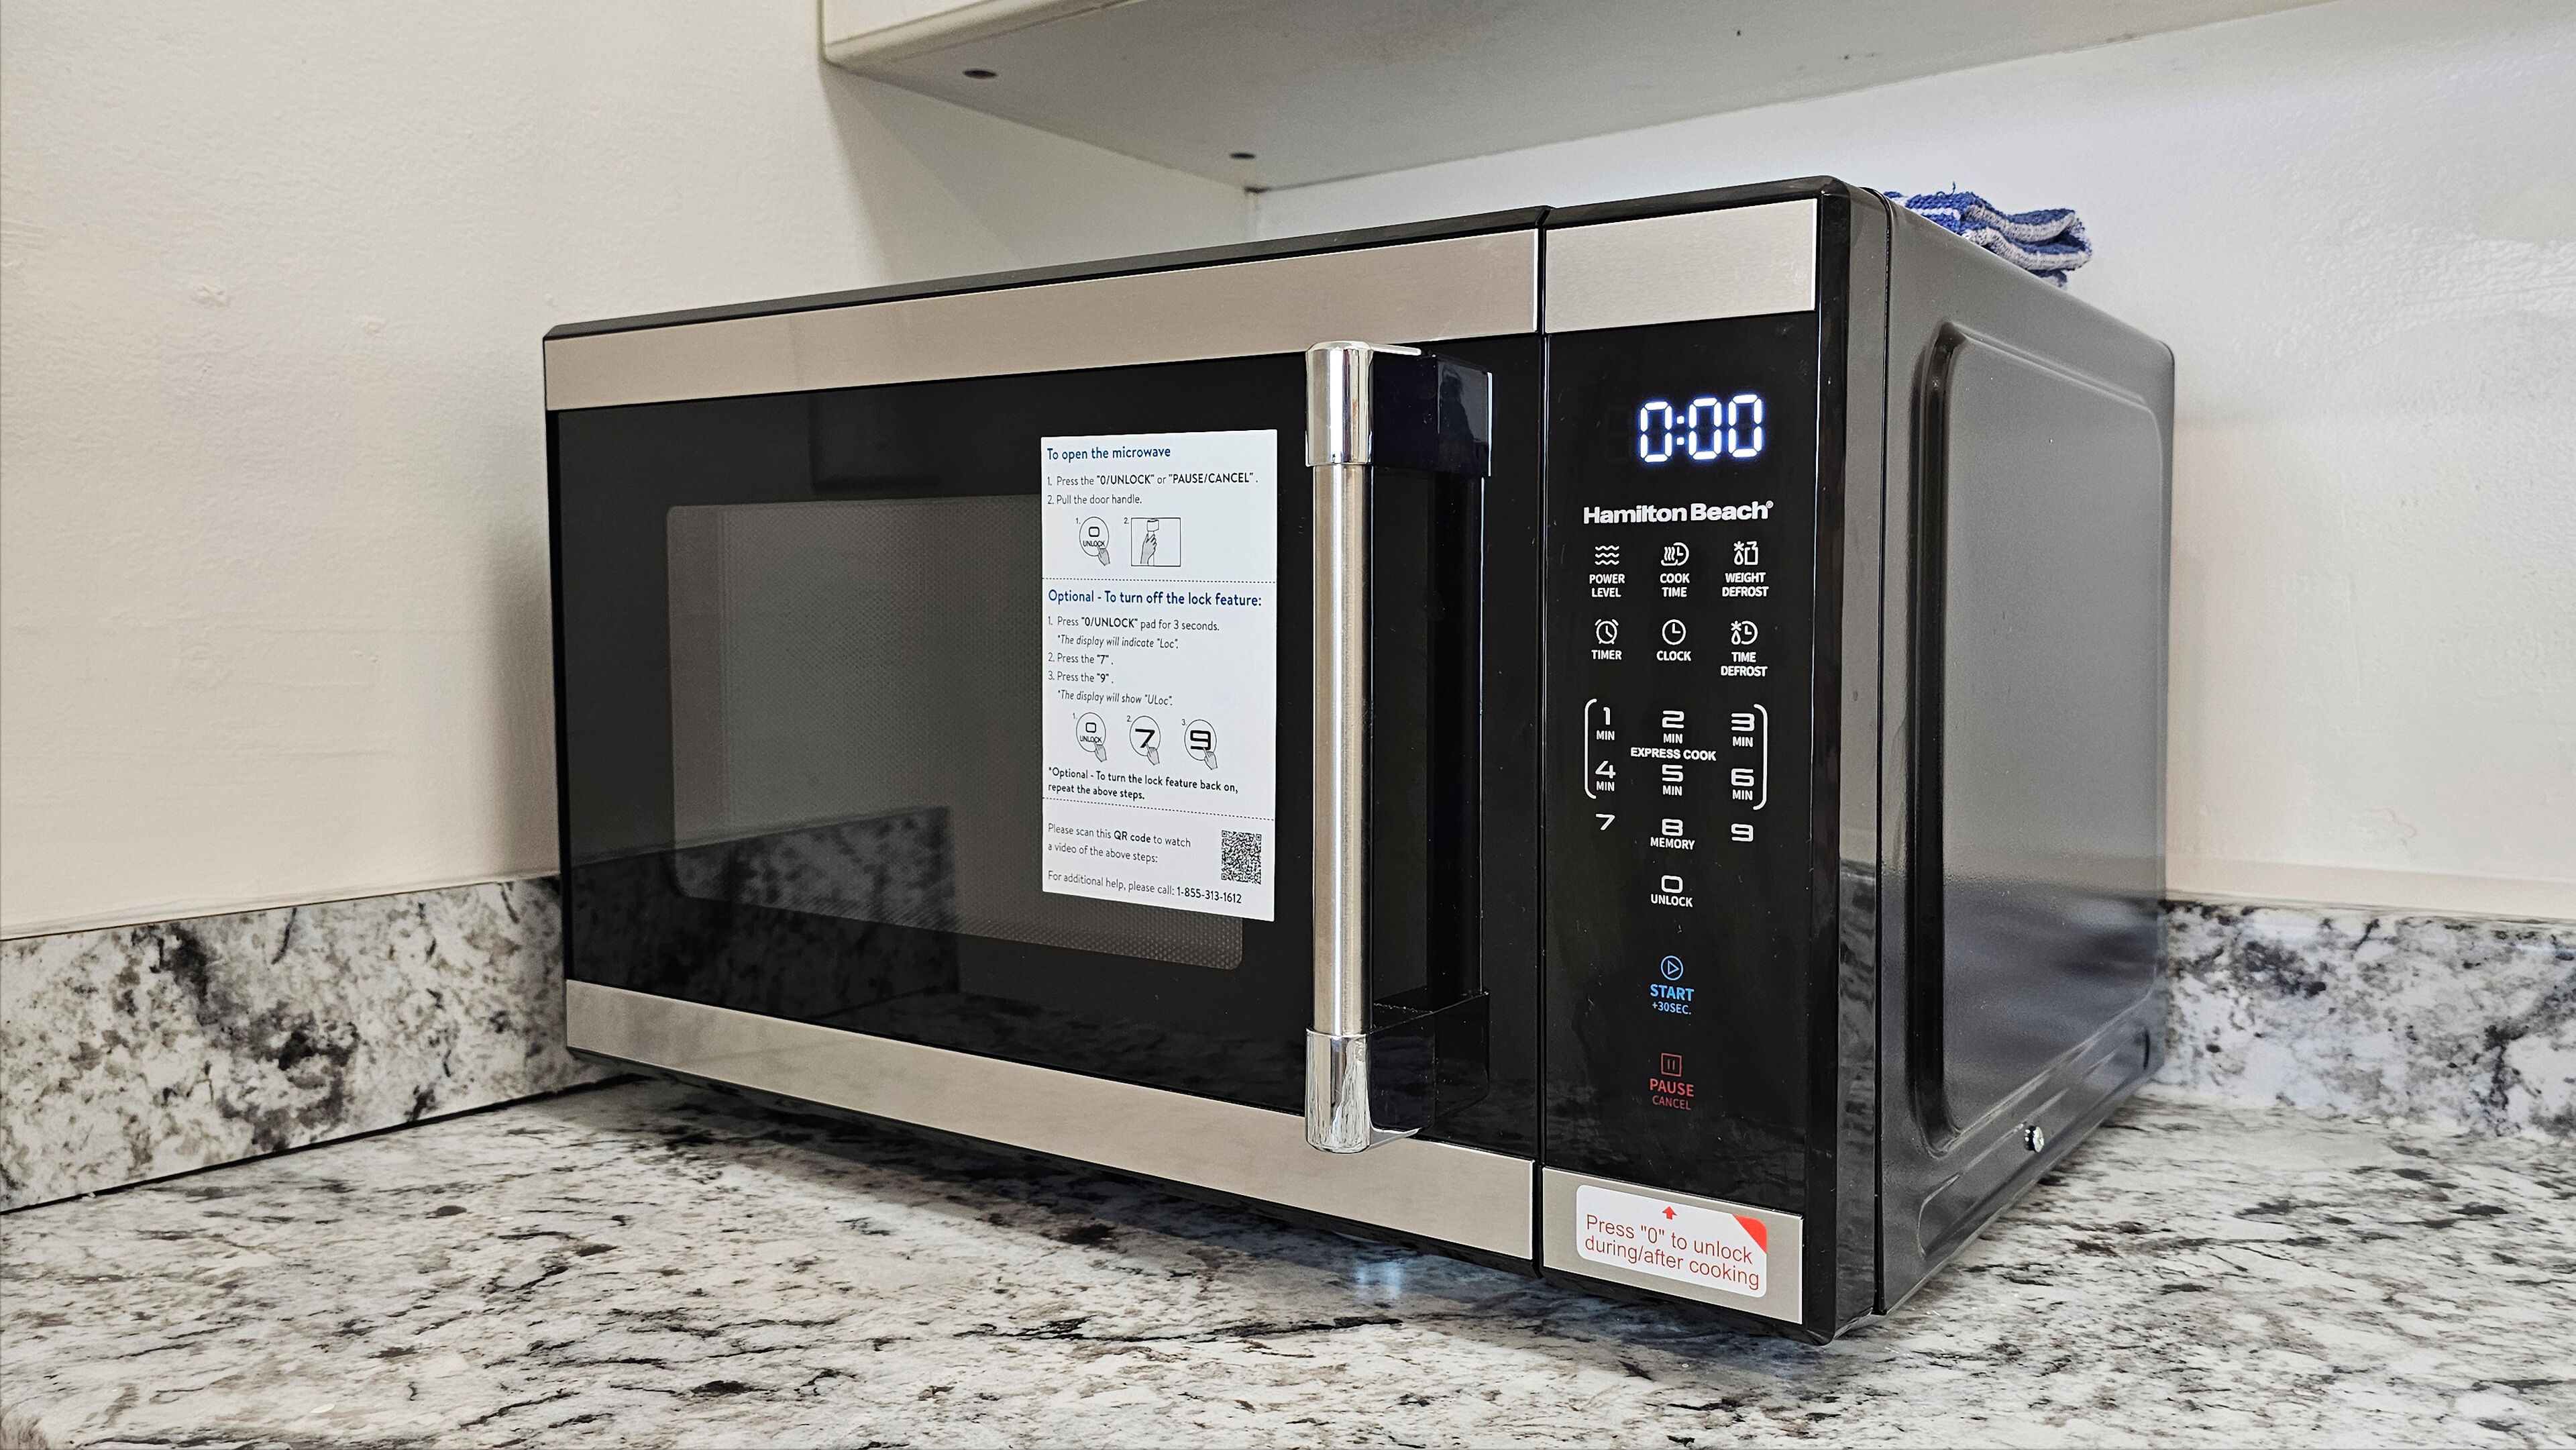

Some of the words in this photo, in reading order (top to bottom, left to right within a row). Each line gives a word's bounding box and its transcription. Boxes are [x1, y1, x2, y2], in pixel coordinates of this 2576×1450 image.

[1640, 394, 1763, 463] 0:00
[1047, 448, 1059, 460] To
[1062, 448, 1087, 462] open
[1091, 447, 1109, 460] the
[1112, 447, 1171, 458] microwave
[1047, 476, 1052, 486] 1.
[1057, 476, 1078, 486] Press
[1081, 475, 1094, 485] the
[1157, 476, 1166, 484] or
[1047, 496, 1054, 505] 2.
[1057, 495, 1071, 505] Pull
[1074, 495, 1087, 504] the
[1089, 495, 1110, 504] door
[1112, 495, 1142, 504] handle.
[1583, 505, 1687, 524] Hamilton
[1589, 574, 1625, 584] POWER
[1660, 573, 1690, 583] COOK
[1725, 572, 1766, 582] WEIGHT
[1049, 589, 1094, 605] Optional
[1104, 590, 1116, 603] To
[1120, 592, 1143, 603] turn
[1146, 591, 1163, 604] off
[1166, 592, 1185, 604] the
[1188, 592, 1212, 605] lock
[1215, 593, 1262, 606] feature:
[1591, 588, 1621, 598] LEVEL
[1662, 587, 1686, 597] TIME
[1722, 586, 1769, 597] DEFROST
[1048, 617, 1053, 625] 1.
[1057, 617, 1079, 626] Press
[1140, 619, 1156, 631] pad
[1159, 619, 1171, 629] for
[1174, 620, 1179, 629] 3
[1181, 621, 1220, 631] seconds.
[1076, 636, 1104, 648] display
[1107, 637, 1120, 646] will
[1122, 637, 1154, 648] indicate
[1049, 654, 1055, 662] 2.
[1057, 653, 1079, 664] Press
[1081, 654, 1094, 664] the
[1591, 650, 1622, 660] TIMER
[1656, 651, 1691, 662] CLOCK
[1731, 652, 1756, 662] TIME
[1049, 671, 1055, 680] 3.
[1057, 672, 1079, 682] Press
[1081, 673, 1094, 682] the
[1721, 666, 1768, 677] DEFROST
[1076, 691, 1104, 703] display
[1107, 692, 1120, 703] will
[1122, 693, 1142, 704] show
[1603, 707, 1610, 725] 1
[1662, 710, 1684, 729] 2
[1731, 713, 1755, 731] 3
[1135, 728, 1155, 748] 7
[1190, 729, 1212, 750] 9
[1597, 730, 1615, 740] MIN
[1663, 733, 1683, 743] MIN
[1733, 737, 1753, 747] MIN
[1631, 747, 1680, 760] EXPRESS
[1683, 749, 1717, 762] COOK
[1595, 761, 1616, 779] 4
[1662, 764, 1683, 782] 5
[1731, 768, 1754, 787] 6
[1096, 770, 1106, 780] To
[1108, 773, 1126, 782] turn
[1128, 774, 1142, 784] the
[1144, 775, 1163, 786] lock
[1165, 777, 1197, 788] feature
[1200, 780, 1221, 791] back
[1224, 784, 1238, 793] on,
[1597, 781, 1615, 792] MIN
[1049, 784, 1074, 794] repeat
[1077, 784, 1090, 794] the
[1093, 786, 1118, 797] above
[1120, 790, 1144, 801] steps.
[1662, 785, 1682, 796] MIN
[1733, 790, 1753, 800] MIN
[1596, 814, 1615, 831] 7
[1662, 819, 1683, 837] 8
[1049, 823, 1074, 835] Please
[1076, 827, 1094, 837] scan
[1096, 829, 1111, 839] this
[1114, 831, 1127, 841] QR
[1130, 832, 1151, 843] code
[1153, 835, 1163, 844] to
[1165, 837, 1191, 847] watch
[1731, 823, 1754, 842] 9
[1650, 837, 1695, 850] MEMORY
[1055, 843, 1077, 853] video
[1079, 845, 1088, 856] of
[1090, 846, 1104, 857] the
[1106, 849, 1130, 860] above
[1132, 851, 1158, 864] steps:
[1049, 871, 1061, 881] For
[1064, 873, 1104, 886] additional
[1106, 878, 1126, 891] help,
[1128, 881, 1155, 894] please
[1157, 886, 1174, 895] call:
[1177, 886, 1242, 904] 1-855-313-1612
[1651, 894, 1693, 907] UNLOCK
[1650, 984, 1695, 1001] START
[1652, 1000, 1692, 1015] +30SEC.
[1650, 1078, 1694, 1097] PAUSE
[1652, 1095, 1691, 1110] CANCEL
[1587, 1214, 1634, 1239] Press
[1671, 1231, 1687, 1250] to
[1694, 1236, 1753, 1265] unlock
[1585, 1235, 1683, 1270] during/after
[1689, 1260, 1760, 1290] cooking
